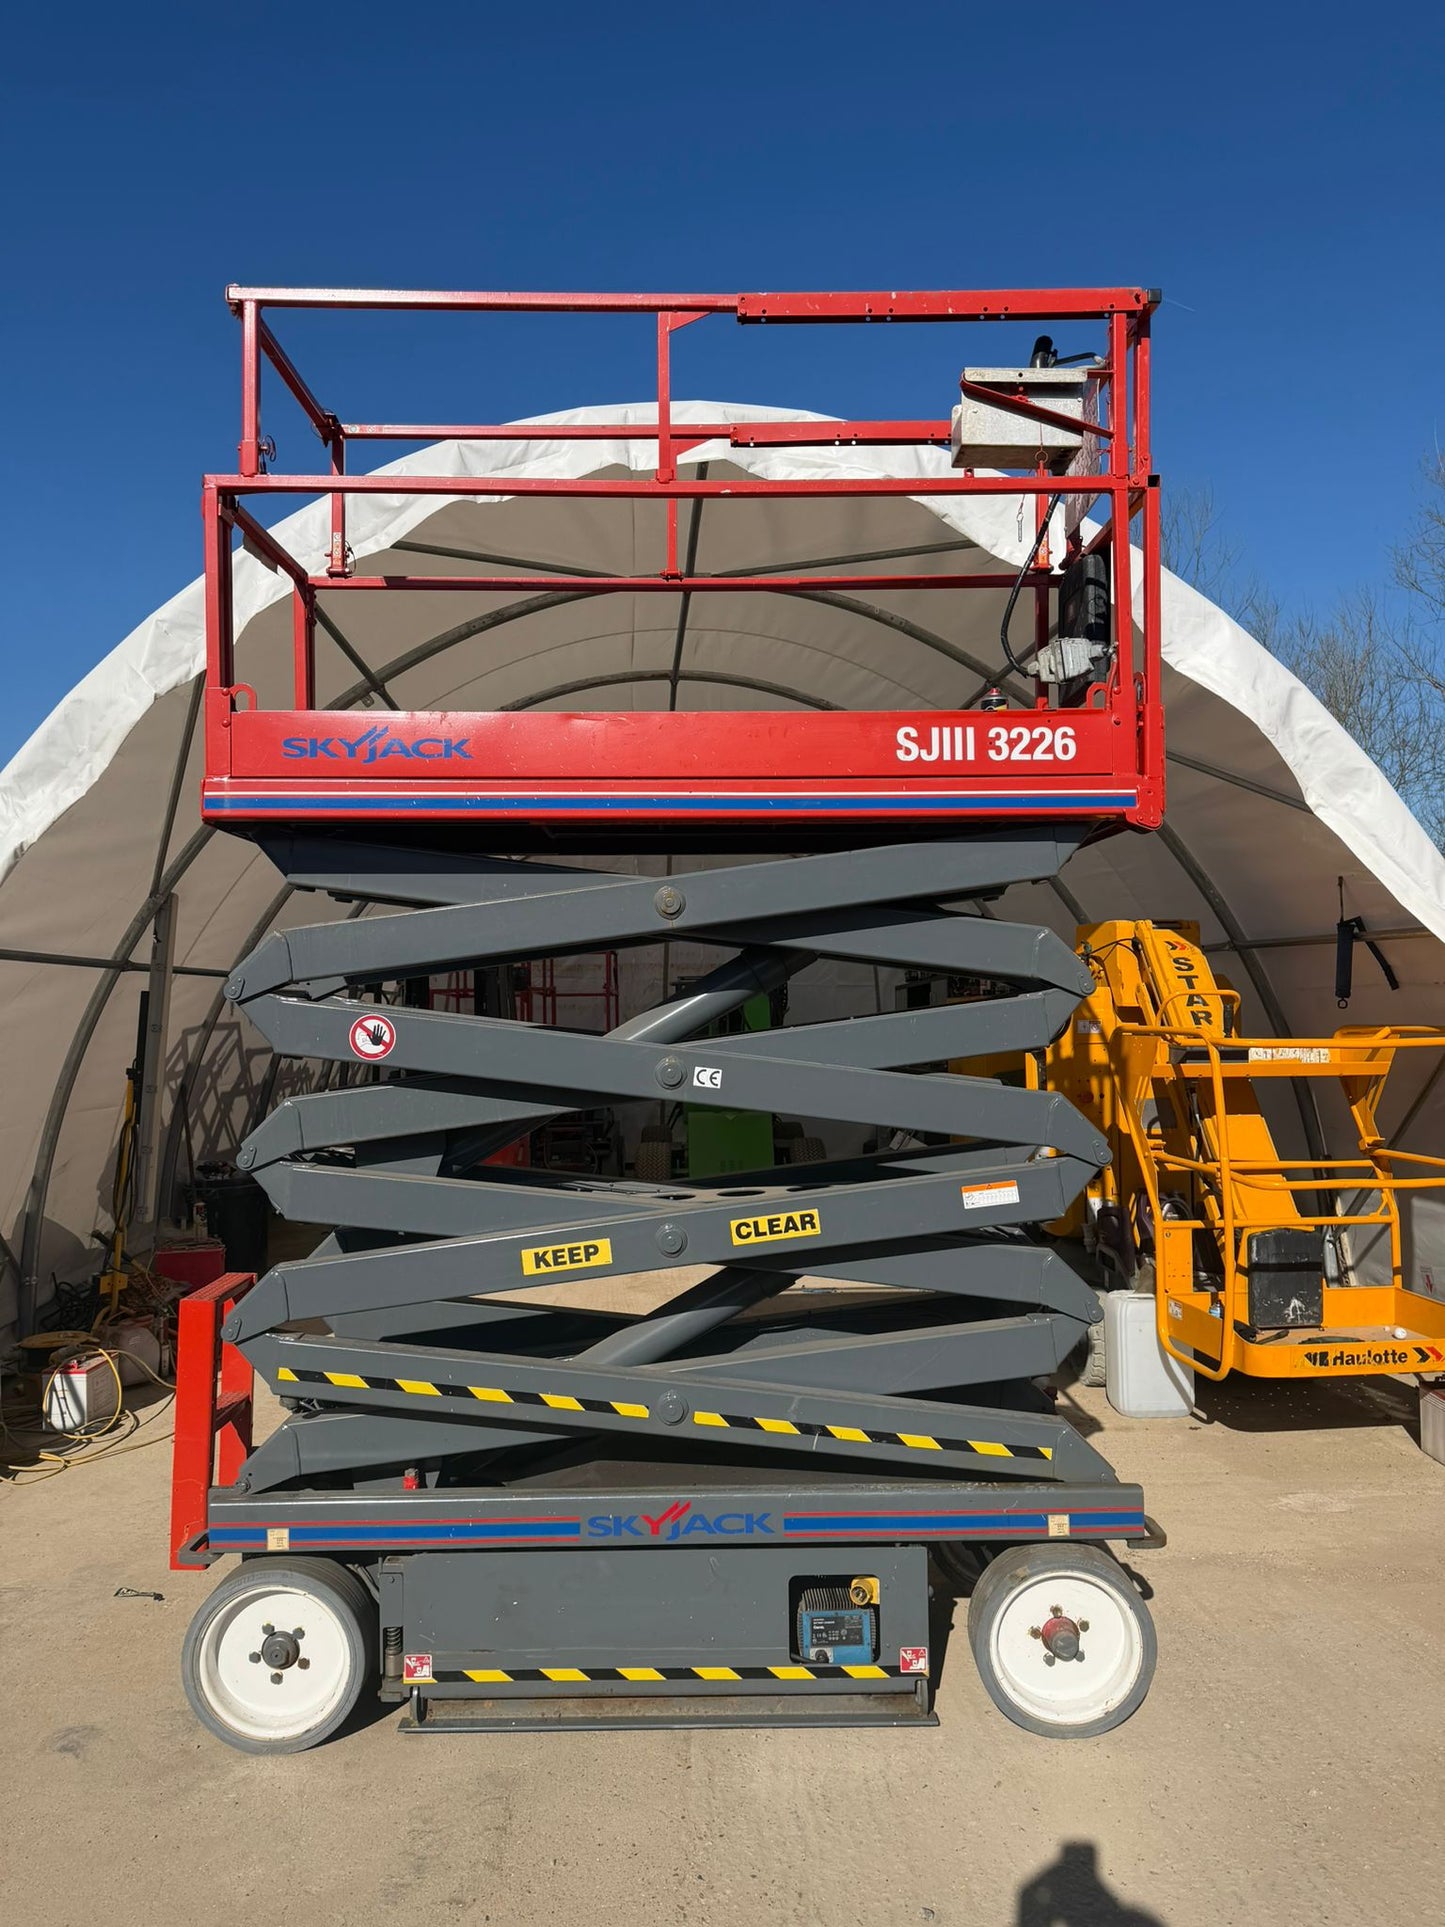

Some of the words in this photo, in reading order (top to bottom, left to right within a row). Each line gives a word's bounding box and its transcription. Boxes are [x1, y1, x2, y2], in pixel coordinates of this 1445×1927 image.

[282, 725, 474, 764] SKYJACK
[896, 726, 975, 761] SJIII
[988, 726, 1077, 761] 3226
[1173, 957, 1213, 1025] STAR
[696, 1069, 720, 1087] CE
[735, 1213, 817, 1239] CLEAR
[534, 1244, 599, 1269] KEEP
[587, 1501, 775, 1541] SKYJACK
